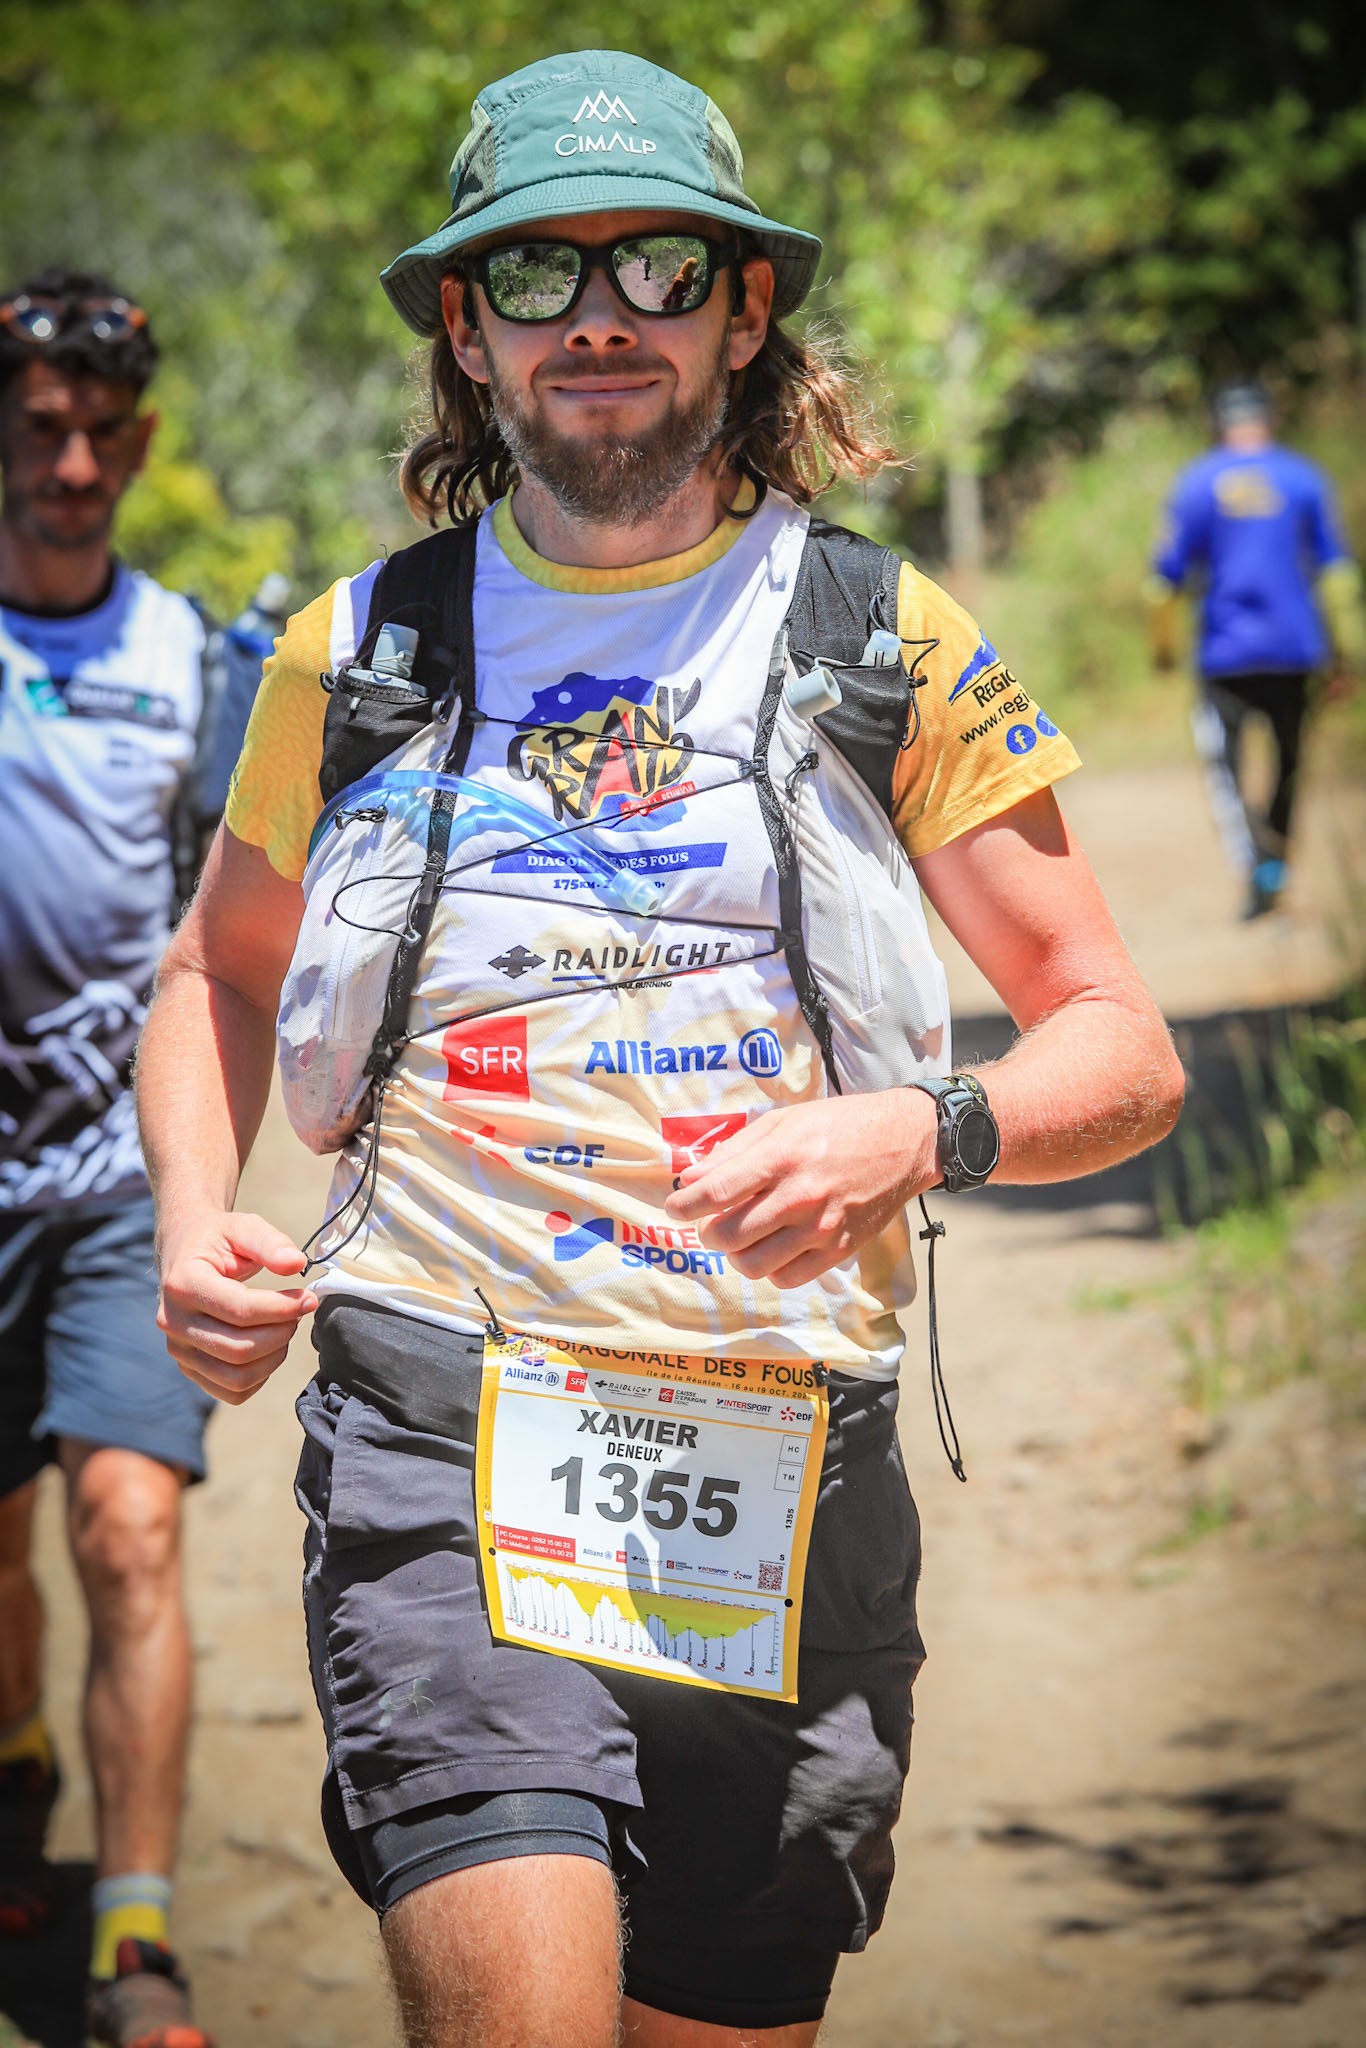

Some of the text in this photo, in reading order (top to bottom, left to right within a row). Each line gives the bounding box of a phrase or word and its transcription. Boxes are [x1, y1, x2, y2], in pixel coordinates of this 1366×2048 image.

[555, 131, 657, 157] CIMALP
[507, 677, 701, 782] GRAND
[650, 852, 689, 867] FOUS
[553, 942, 731, 971] RAIDLIGHT
[635, 980, 672, 989] RUNNING
[460, 1045, 524, 1075] SFR
[585, 1041, 728, 1075] Allianz
[622, 1221, 701, 1248] INTE
[621, 1244, 727, 1275] SPORT
[556, 1339, 689, 1371] DIAGONALE
[704, 1357, 747, 1379] DES
[762, 1364, 814, 1388] FOUS
[505, 1367, 543, 1382] Allianz
[570, 1377, 586, 1387] SFR
[674, 1373, 683, 1381] la
[687, 1375, 721, 1388] Réunion
[609, 1382, 653, 1394] RAIDLIGHT
[675, 1389, 697, 1398] CAISSE
[724, 1400, 773, 1413] INTERSPORT
[577, 1409, 699, 1449] XAVIER
[606, 1442, 664, 1463] DENEUX
[783, 1473, 795, 1481] TM
[551, 1456, 740, 1537] 1355
[785, 1508, 795, 1529] 1355
[508, 1532, 528, 1541] Course
